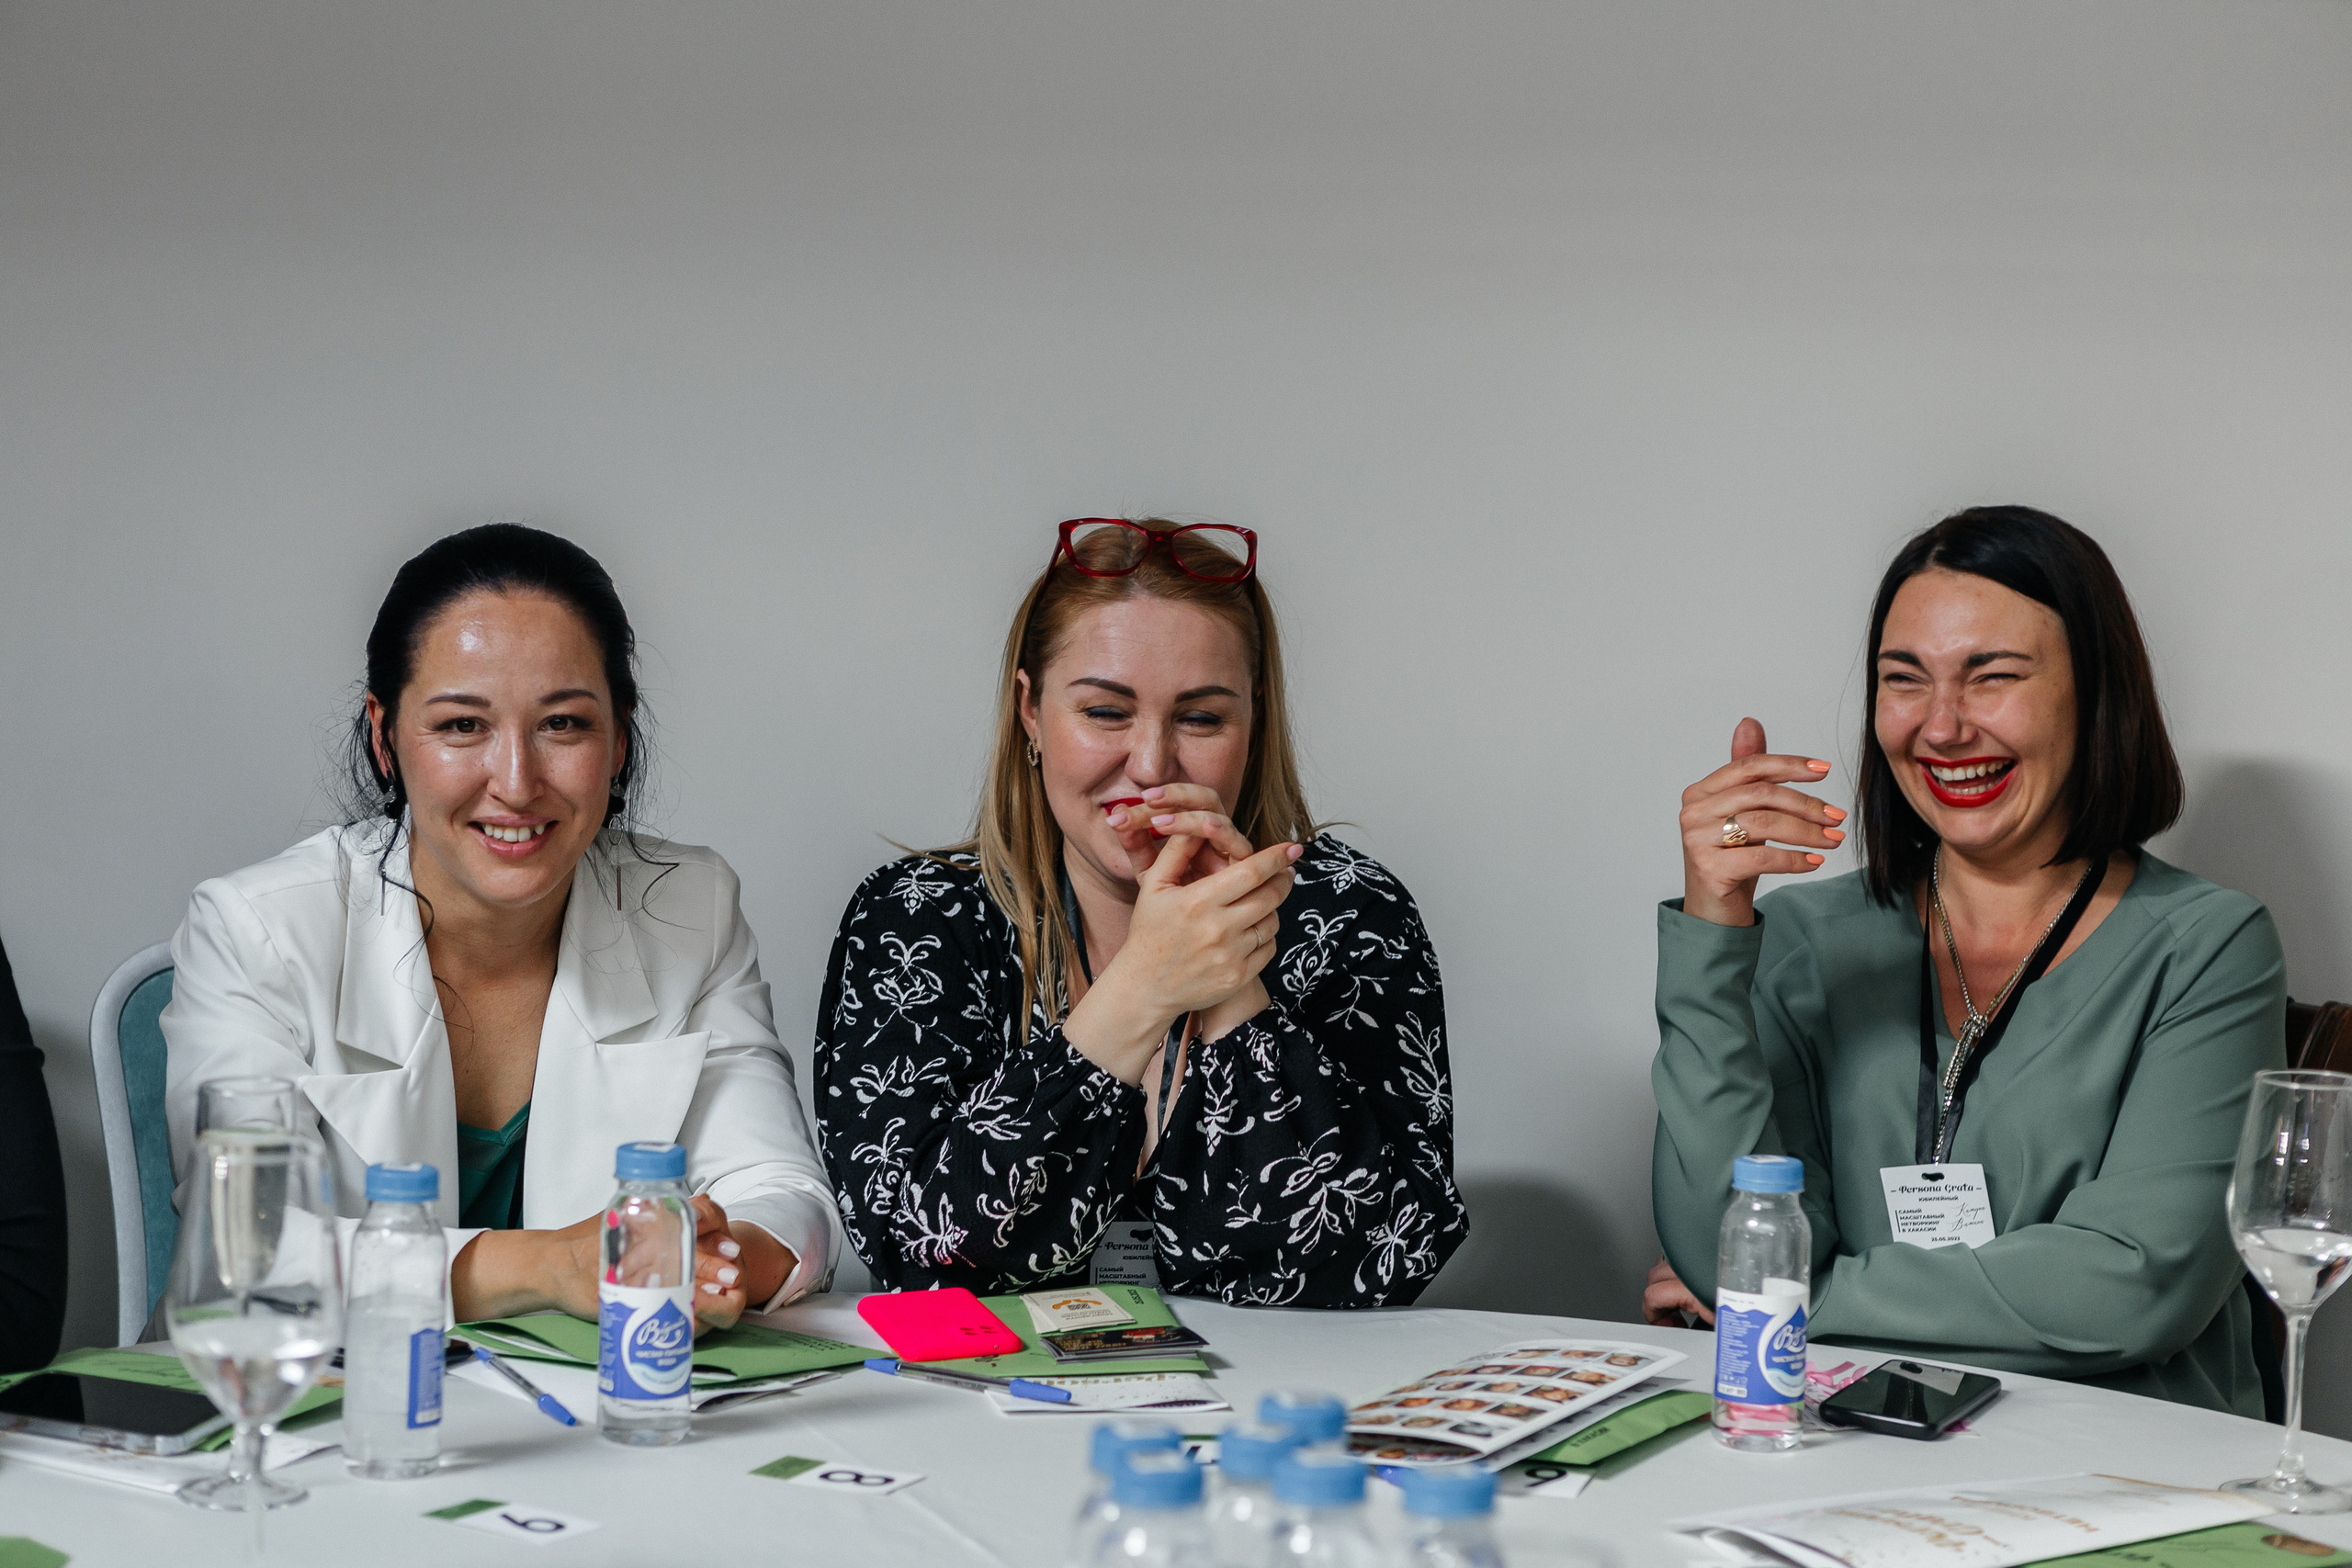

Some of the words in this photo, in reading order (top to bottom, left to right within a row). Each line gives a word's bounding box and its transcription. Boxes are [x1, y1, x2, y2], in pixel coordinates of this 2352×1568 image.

[1898, 1184, 1941, 1194] Persona
[1944, 1183, 1974, 1193] Grata
[1104, 1241, 1149, 1250] Persona
[819, 1470, 896, 1487] 8
